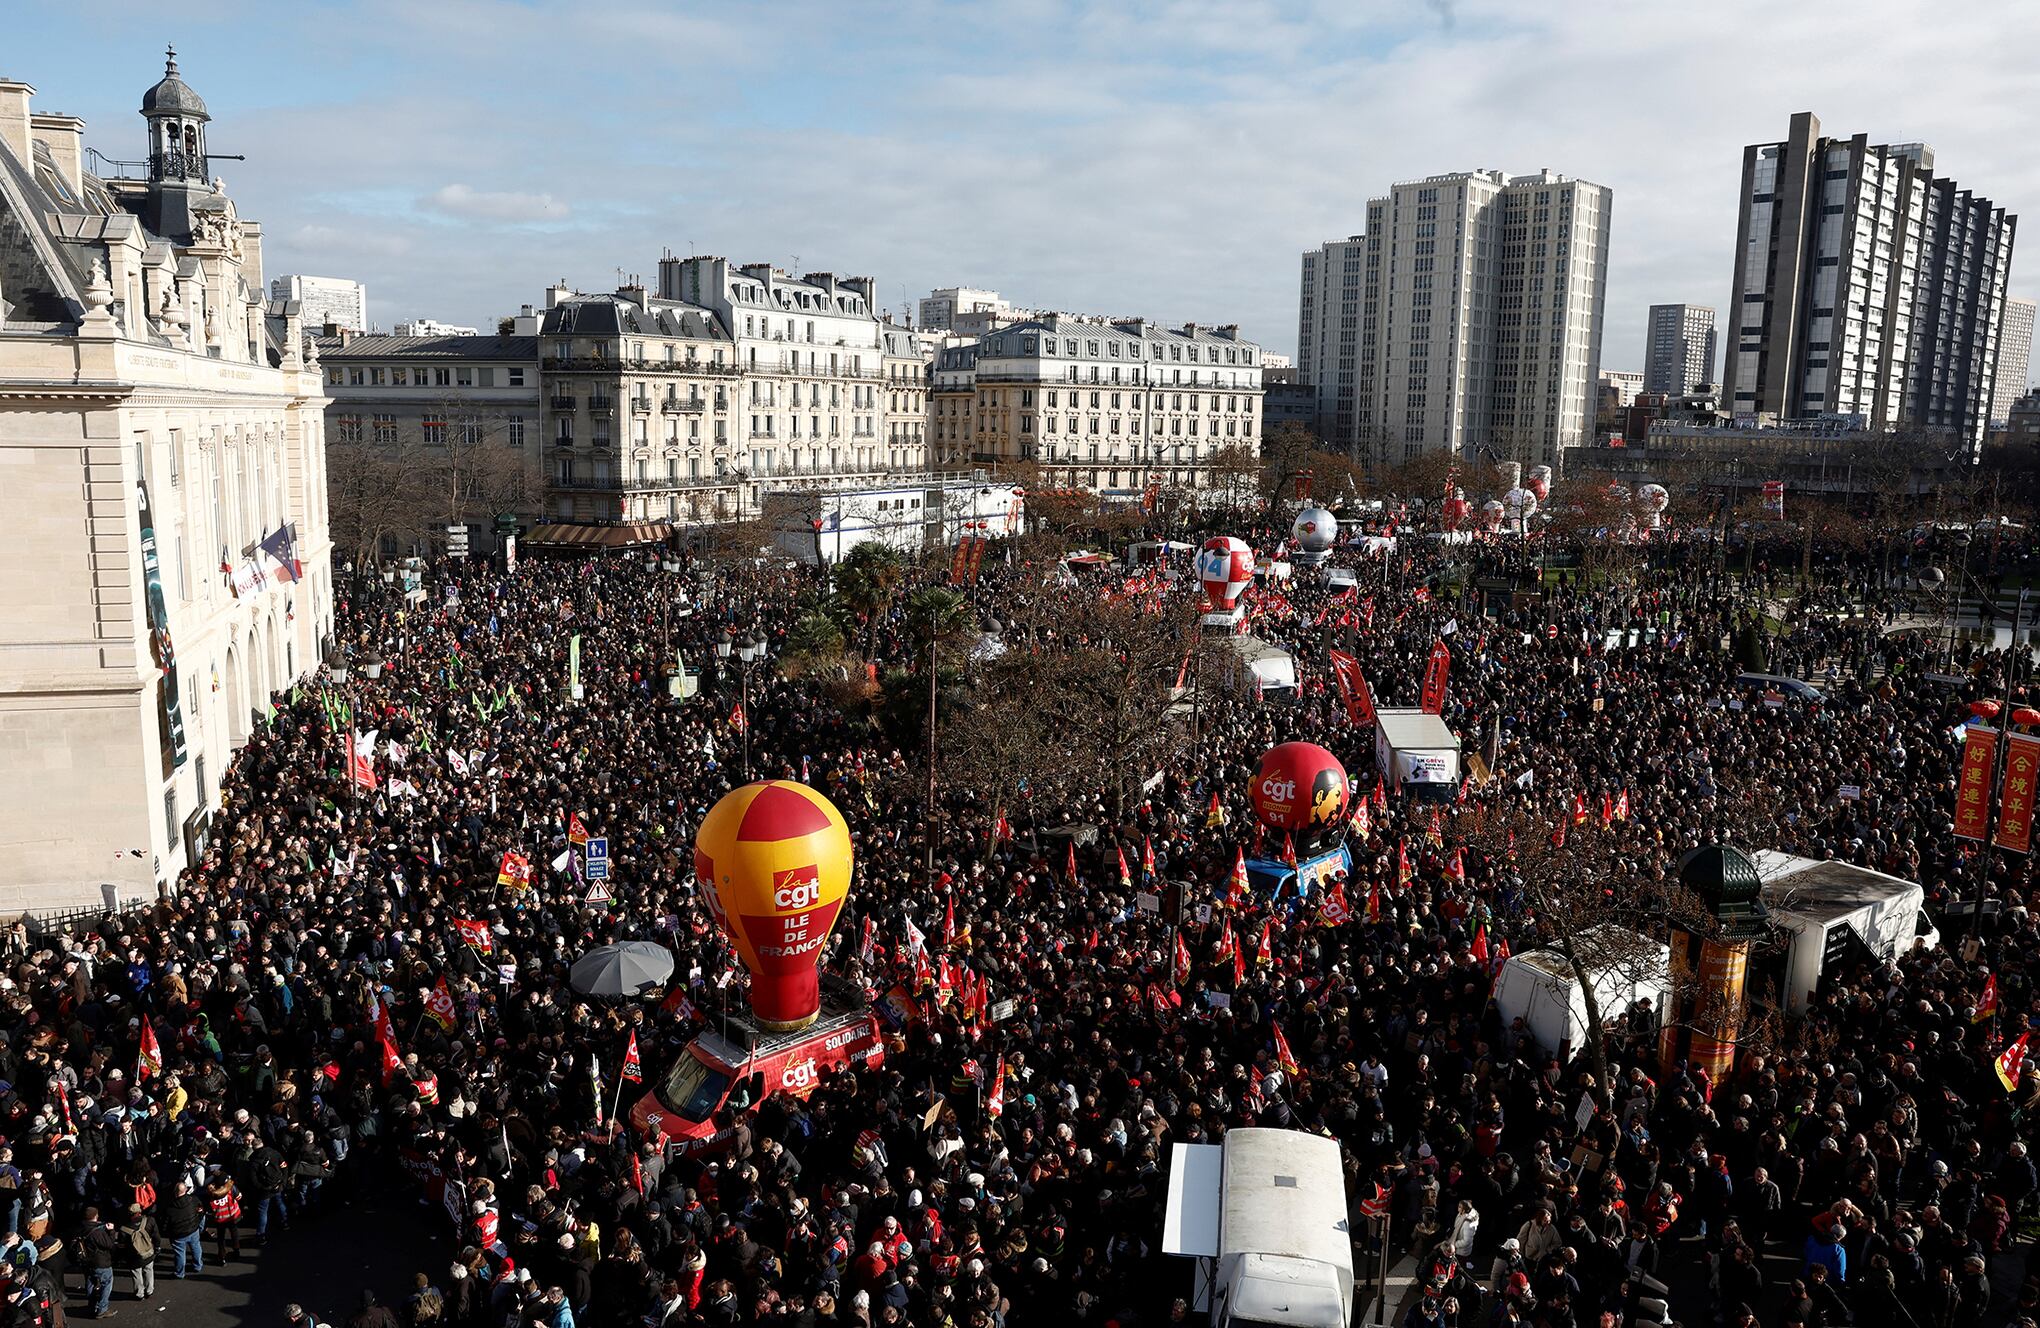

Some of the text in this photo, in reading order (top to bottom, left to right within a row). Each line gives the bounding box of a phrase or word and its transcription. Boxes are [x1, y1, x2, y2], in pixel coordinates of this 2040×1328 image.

[1262, 780, 1296, 803] cgt
[1962, 745, 1987, 825] 好運連年
[2004, 755, 2032, 836] 合境平安
[1263, 802, 1291, 813] ESSONNE
[1269, 812, 1284, 823] 91
[505, 862, 529, 880] cgt
[774, 877, 820, 909] cgt
[784, 914, 809, 929] ILE
[759, 933, 826, 957] FRANCE
[784, 930, 807, 943] DE
[825, 1024, 871, 1051] SOLIDAIRE
[782, 1057, 817, 1088] cgt
[646, 1113, 663, 1125] cgt
